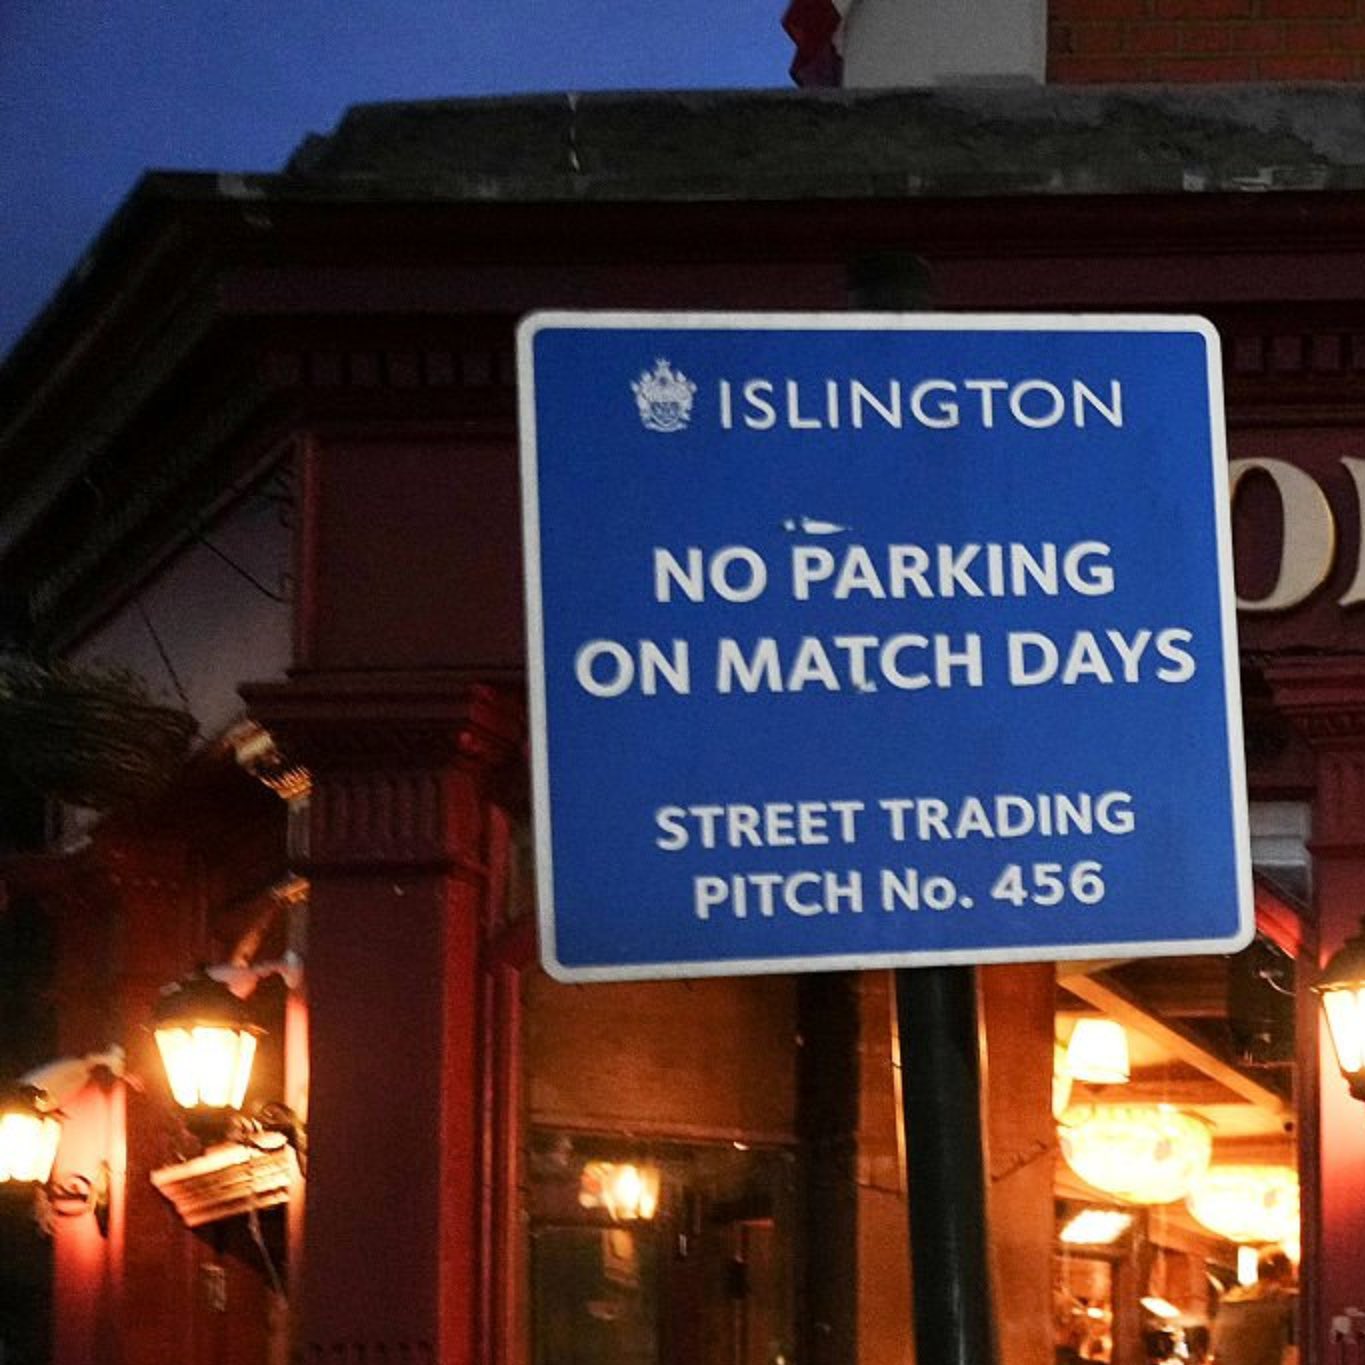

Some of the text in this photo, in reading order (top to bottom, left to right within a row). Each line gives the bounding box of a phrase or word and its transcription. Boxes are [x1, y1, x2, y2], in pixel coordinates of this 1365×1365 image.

[719, 379, 1124, 430] ISLINGTON
[654, 541, 1116, 603] NO PARKING
[575, 627, 1197, 697] ON MATCH DAYS
[655, 791, 1136, 851] STREET TRADING
[694, 860, 1106, 919] PITCH No. 456
